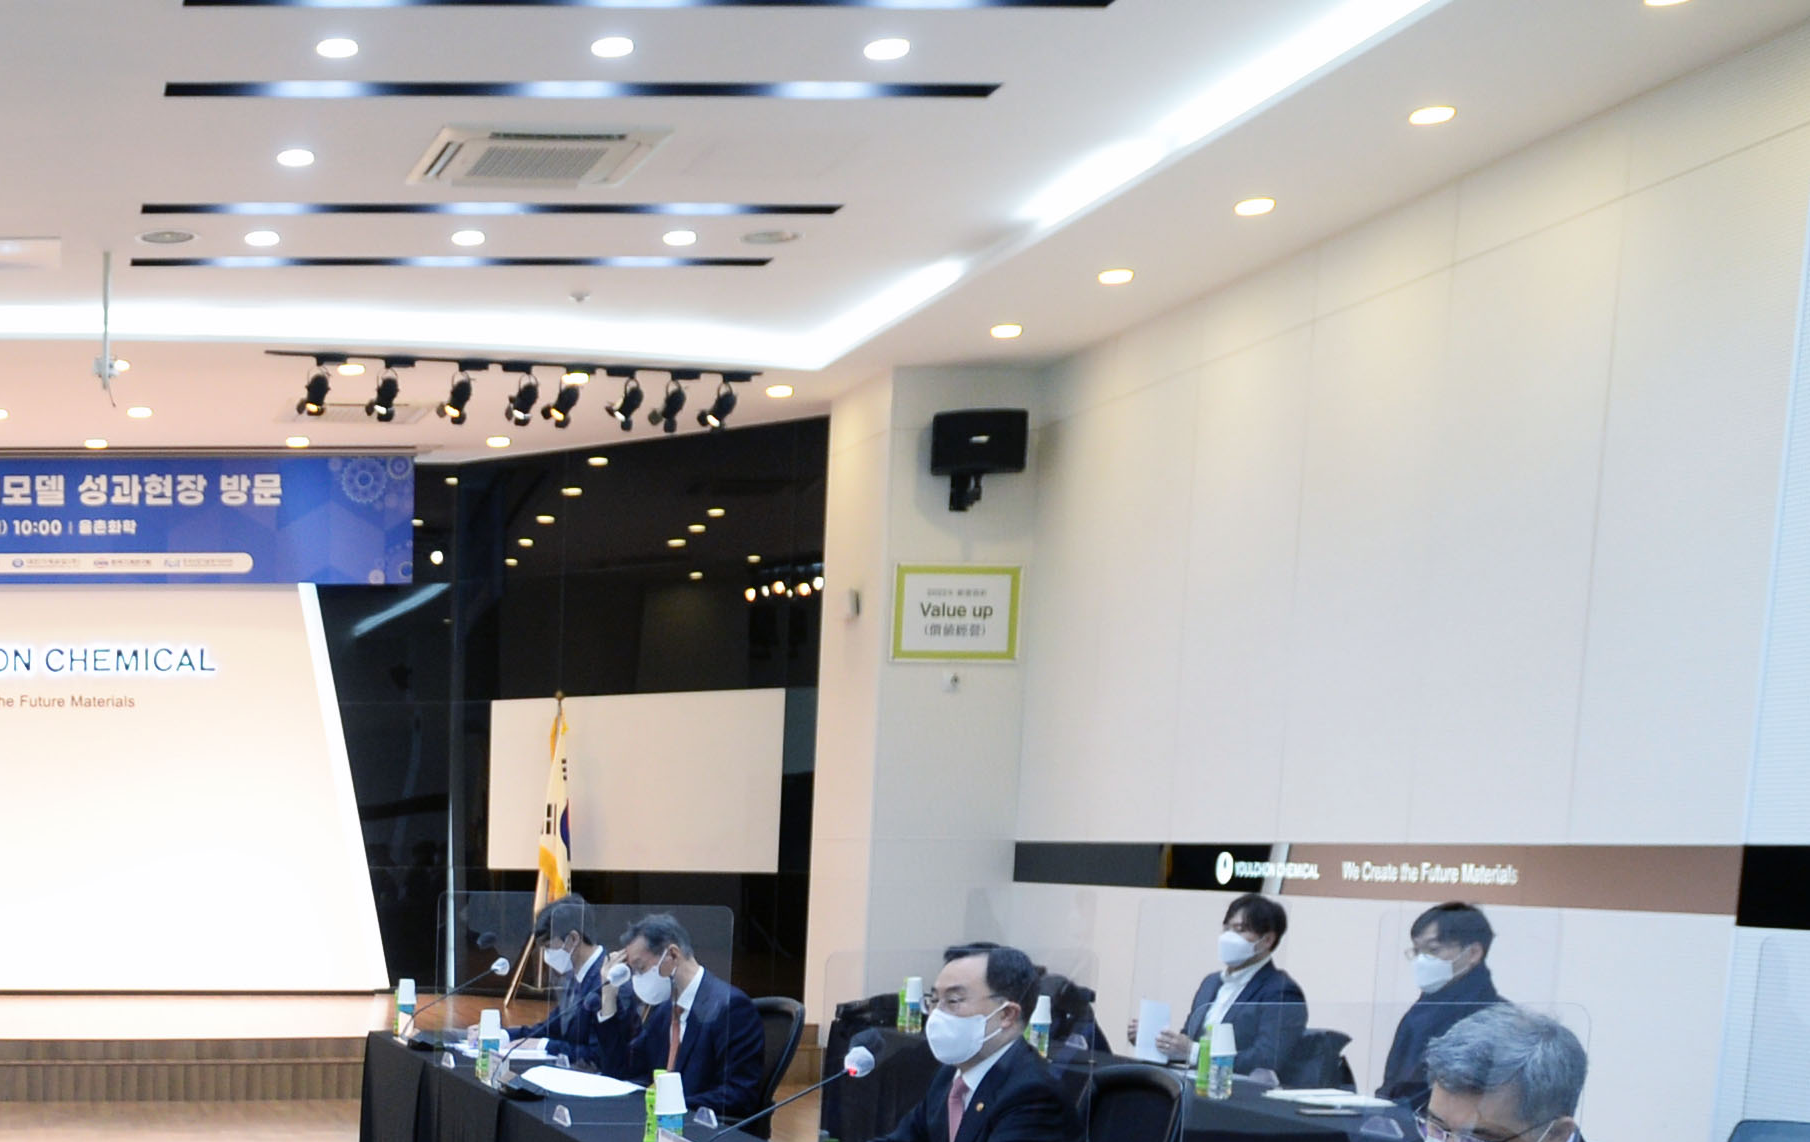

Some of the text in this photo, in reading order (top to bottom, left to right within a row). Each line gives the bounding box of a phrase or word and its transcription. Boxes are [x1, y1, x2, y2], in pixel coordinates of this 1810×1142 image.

[78, 473, 207, 507] 성과현장
[219, 473, 283, 507] 방문
[12, 518, 63, 536] 10:00
[78, 518, 137, 536] 율촌화학
[920, 601, 994, 621] Value up
[45, 647, 216, 672] CHEMICAL
[19, 694, 65, 709] Future
[69, 694, 136, 709] Materials
[1341, 860, 1519, 886] We Create the Future Materials
